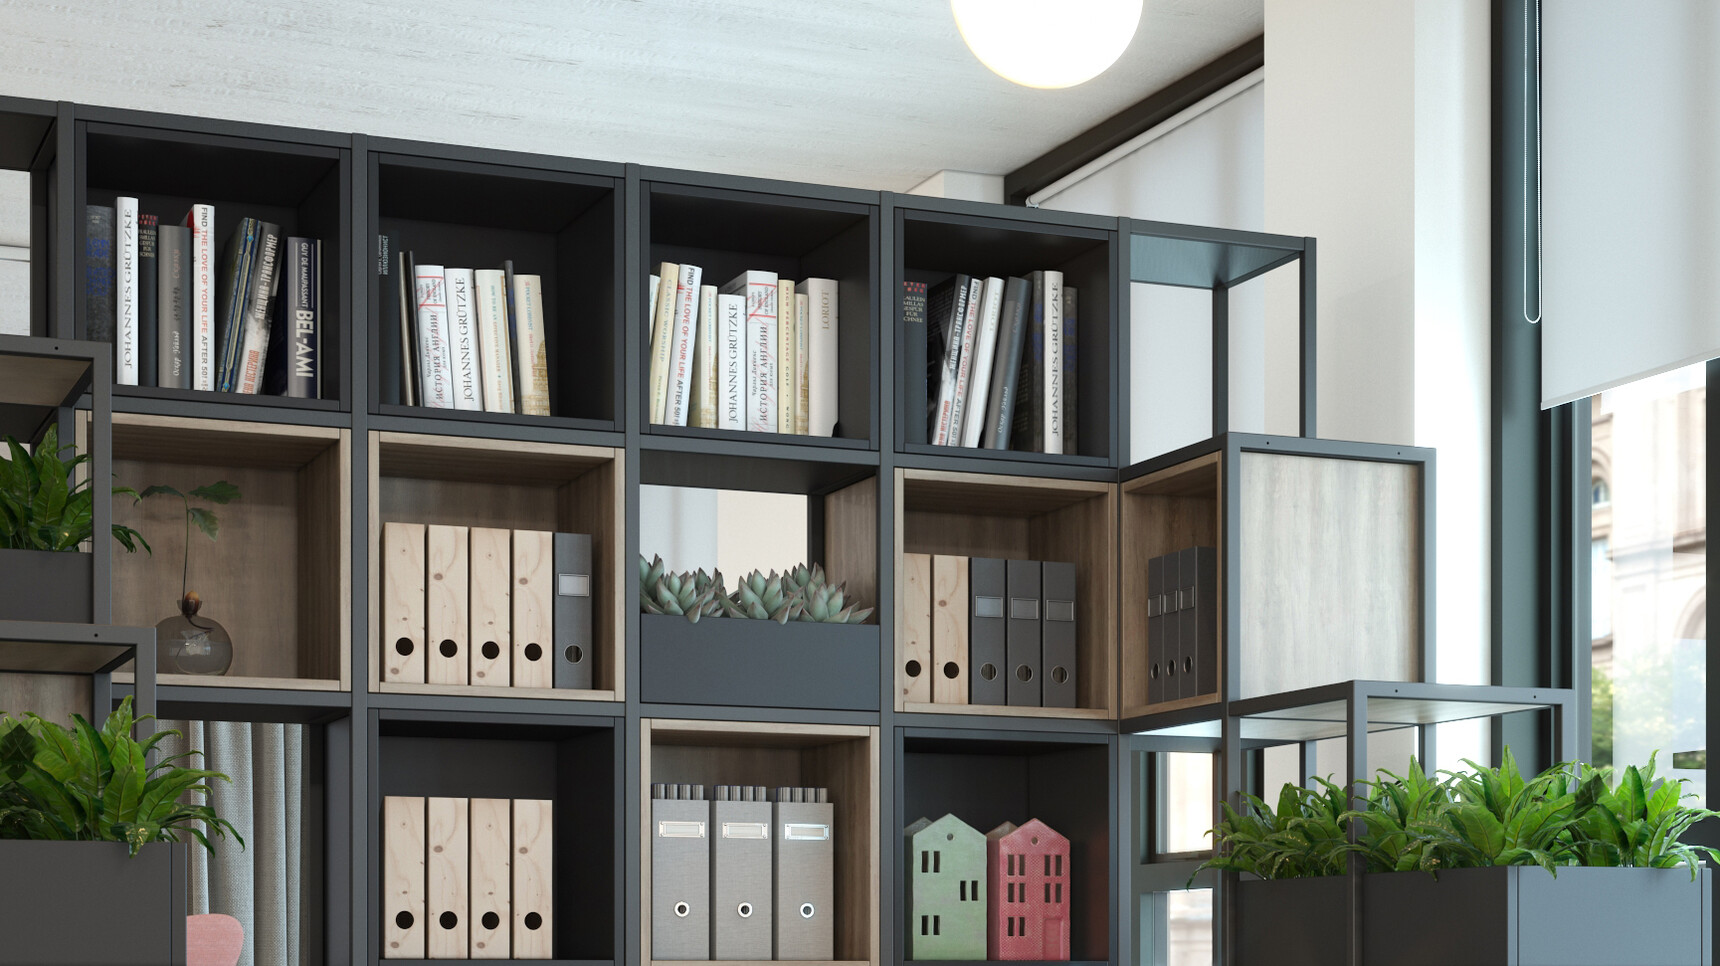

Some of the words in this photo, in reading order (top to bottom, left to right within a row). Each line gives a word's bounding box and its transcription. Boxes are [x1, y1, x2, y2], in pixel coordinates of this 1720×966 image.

[302, 257, 308, 266] DE
[202, 274, 208, 286] OF
[255, 234, 278, 320] ЖЕНЩИНА-ТРАНСФОРМЕР
[972, 281, 980, 300] FIND
[456, 278, 468, 335] GRÜTZKE
[664, 280, 672, 318] CLASSIC
[684, 288, 692, 302] THE
[682, 304, 690, 325] LOVE
[821, 290, 830, 330] LORIOT
[124, 286, 132, 368] JOHANNES
[431, 314, 440, 352] АНГЛИИ
[660, 320, 669, 362] WORSHIP
[682, 326, 688, 337] OF
[728, 304, 738, 359] GRÜTZKE
[172, 330, 180, 356] Уайльд
[296, 310, 314, 377] BEL-AMI
[680, 338, 688, 360] YOUR
[964, 342, 970, 354] OF
[172, 357, 182, 376] Оскар
[244, 350, 260, 382] НЕСТЕРИНА
[434, 356, 444, 400] ИСТОРИЯ
[461, 338, 474, 401] JOHANNES
[678, 362, 686, 378] LIFE
[242, 382, 254, 394] ЕНА
[674, 380, 684, 406] AFTER
[728, 361, 738, 423] JOHANNES
[953, 398, 962, 426] AFTER
